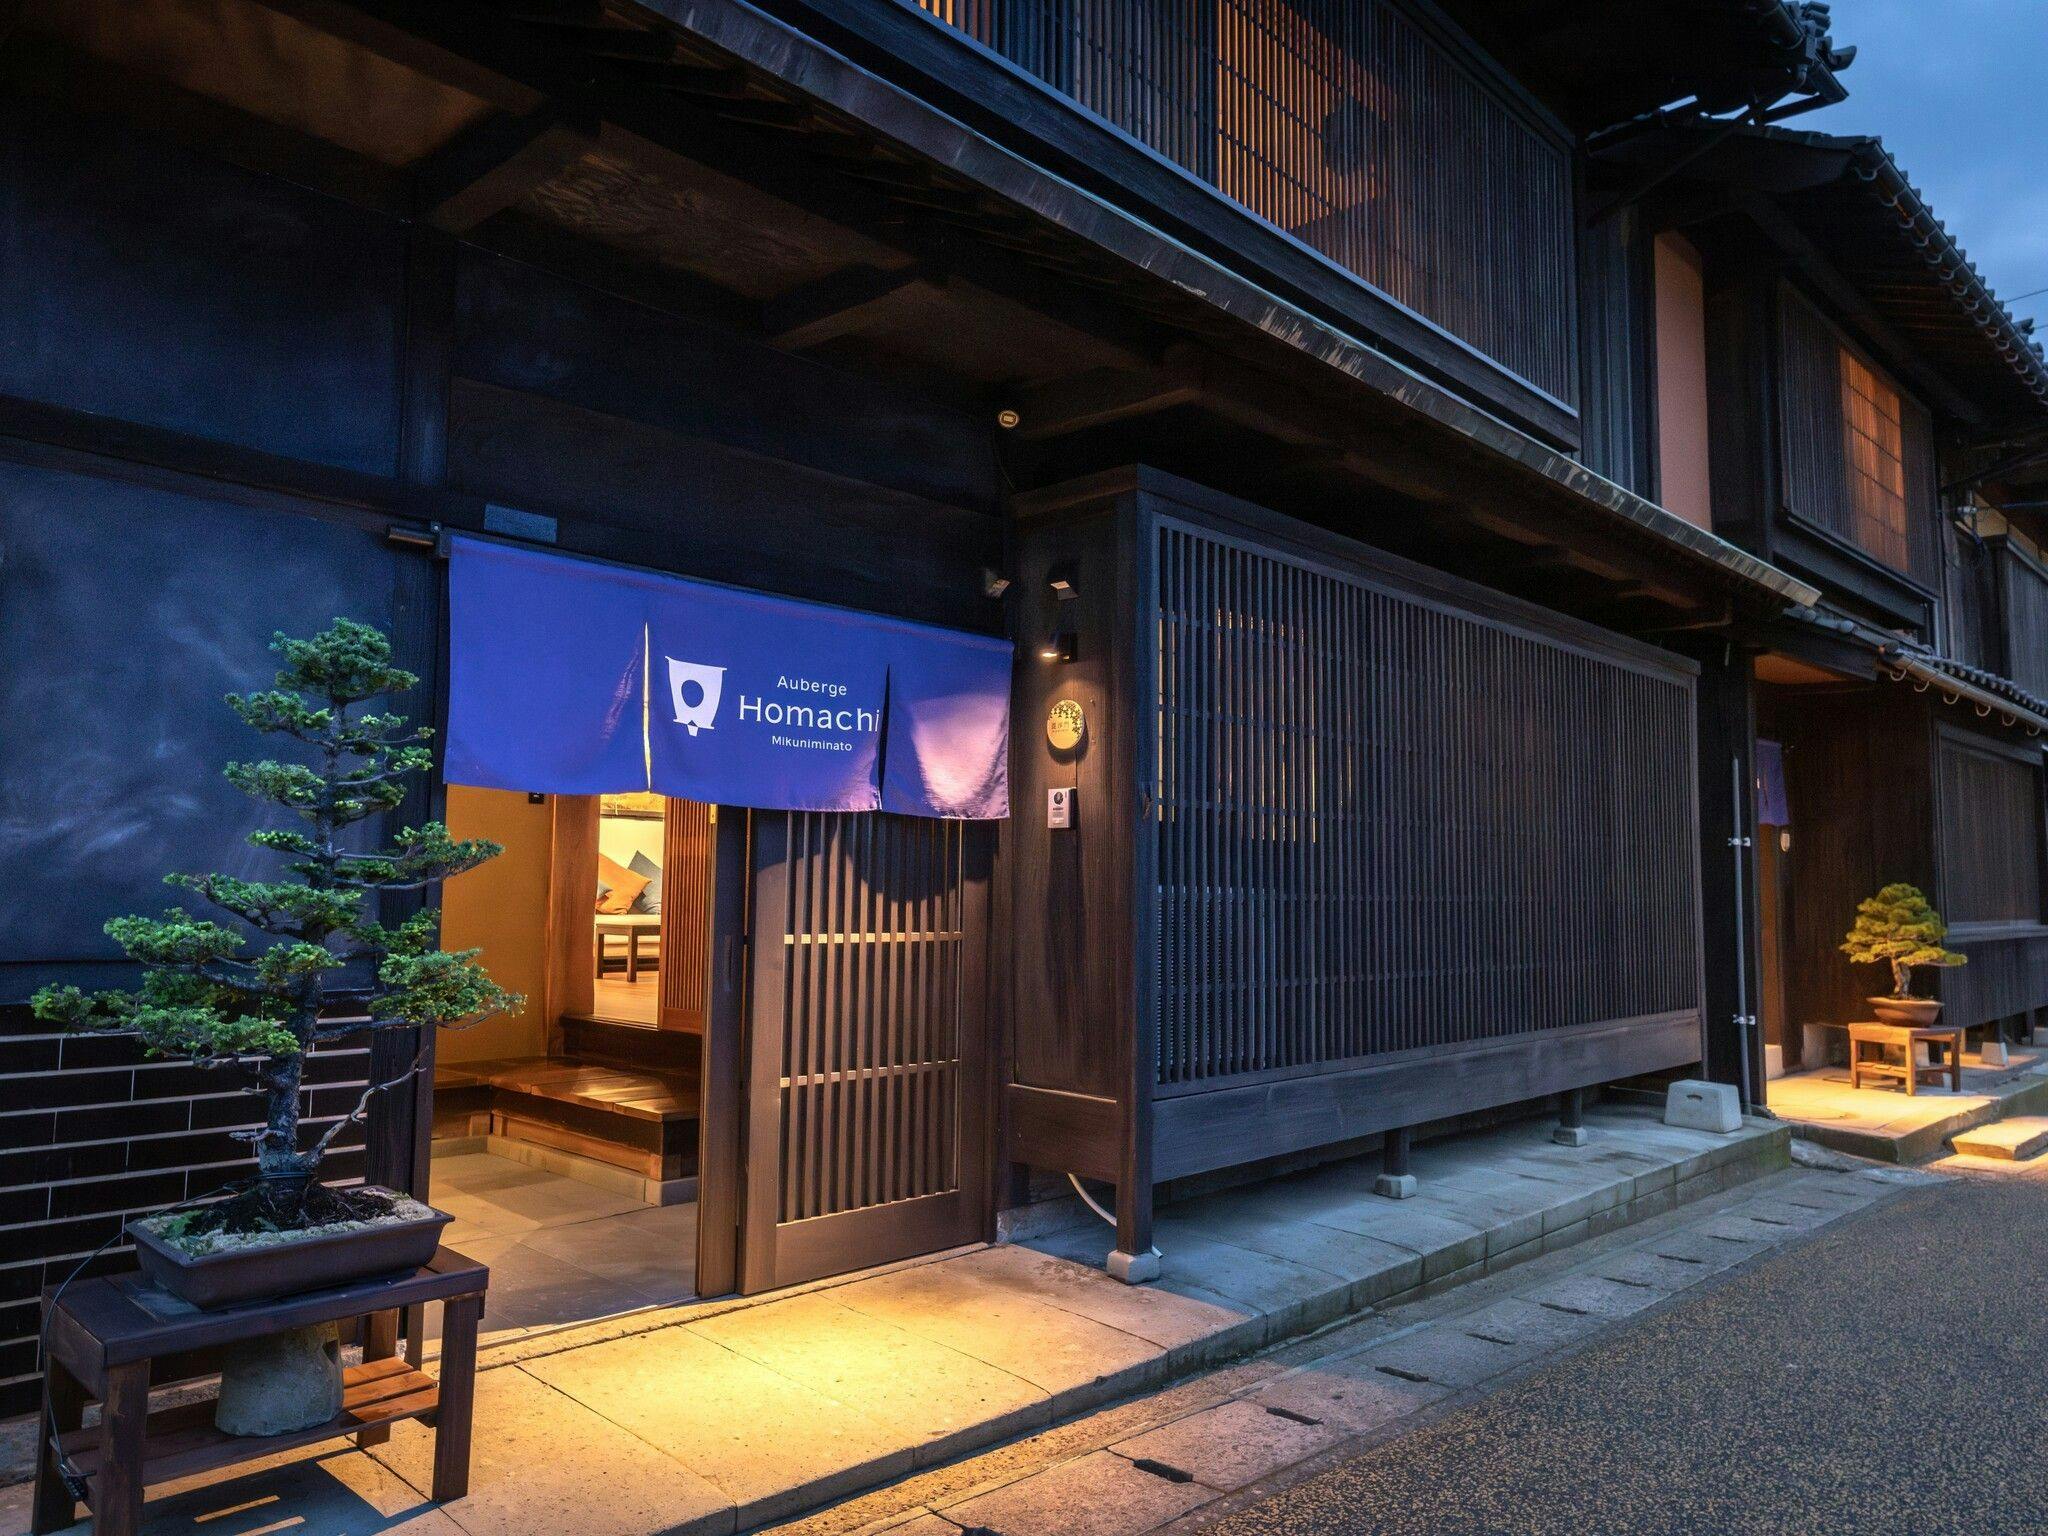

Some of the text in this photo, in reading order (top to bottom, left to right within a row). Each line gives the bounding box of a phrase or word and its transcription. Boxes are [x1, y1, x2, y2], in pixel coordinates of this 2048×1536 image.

[777, 675, 848, 698] Auberge
[739, 695, 880, 732] Homachi
[771, 736, 853, 752] Mikuniminato
